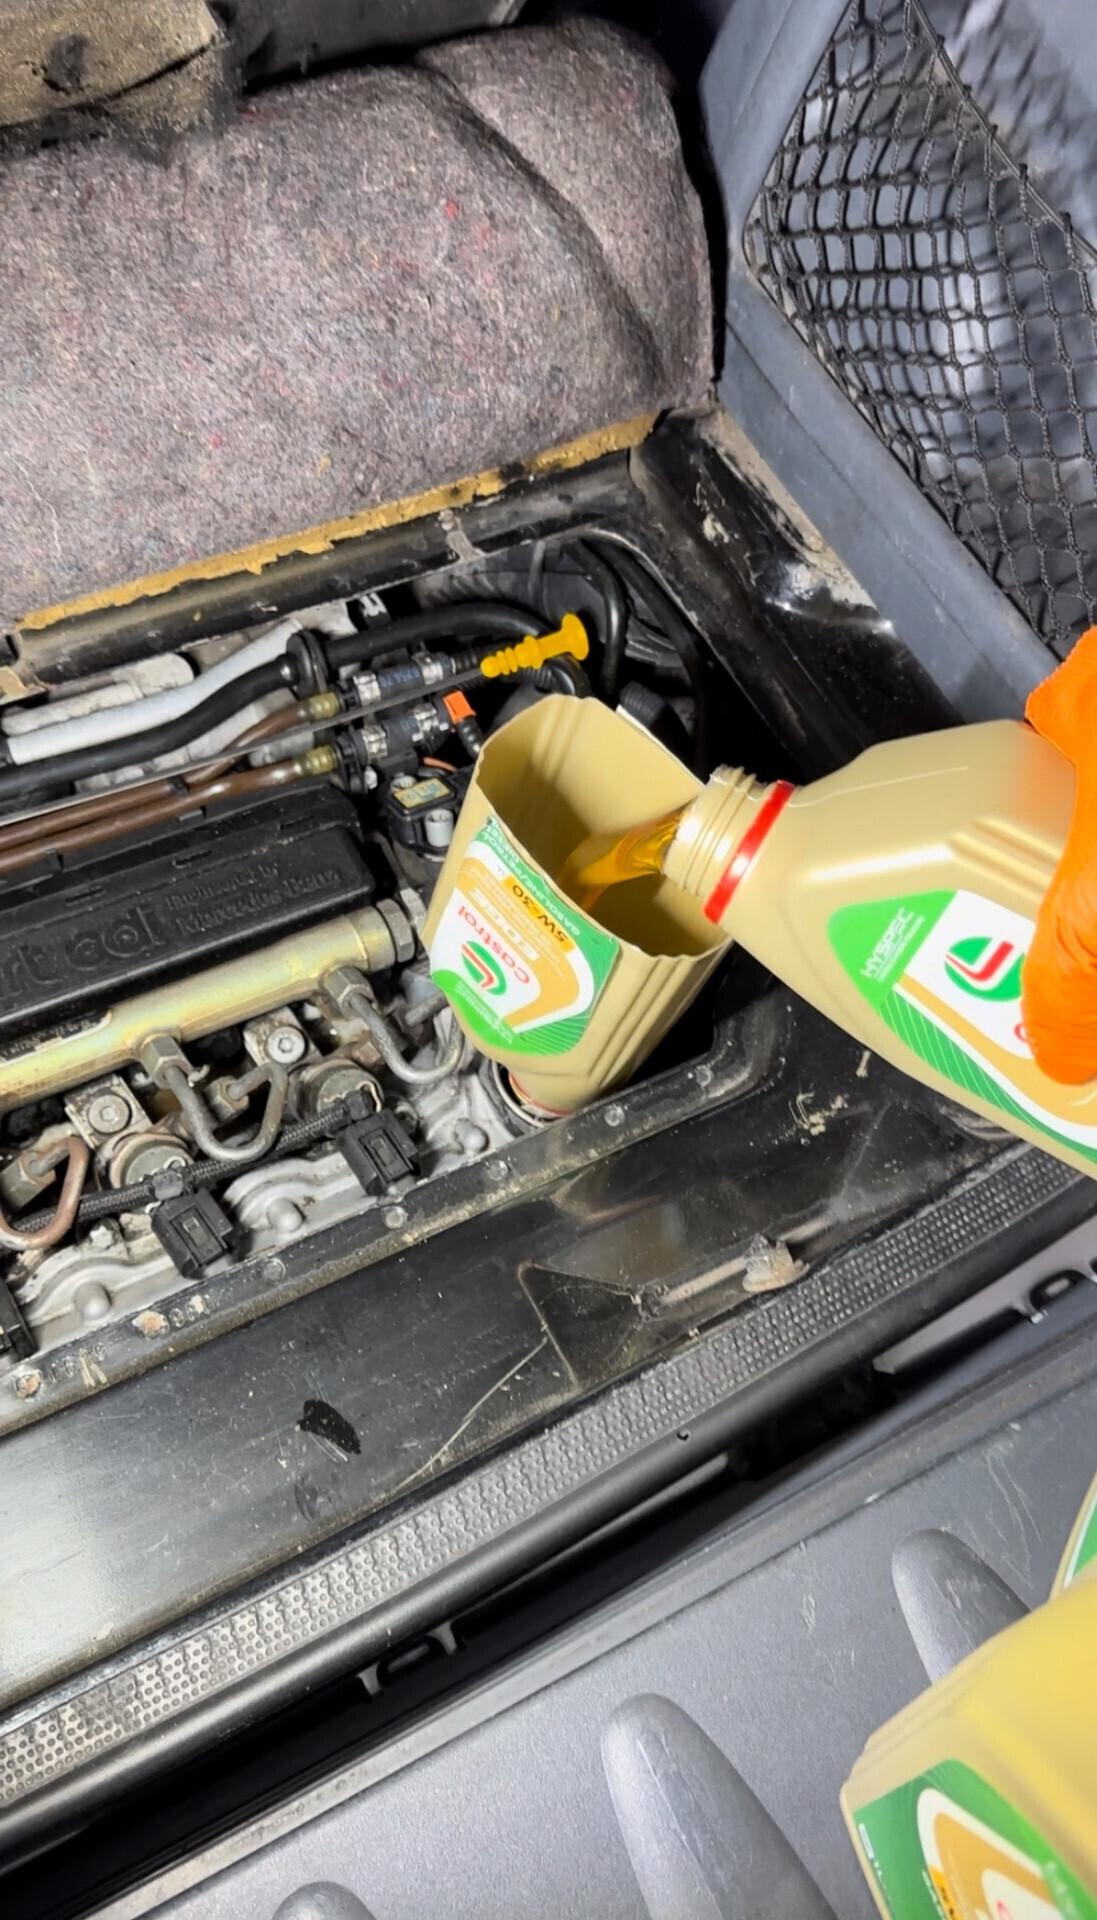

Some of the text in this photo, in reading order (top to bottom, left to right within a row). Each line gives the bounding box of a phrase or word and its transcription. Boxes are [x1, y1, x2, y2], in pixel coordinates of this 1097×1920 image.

[455, 905, 531, 985] Castrol
[510, 884, 568, 942] 5W-30
[859, 906, 914, 978] HYSPEC
